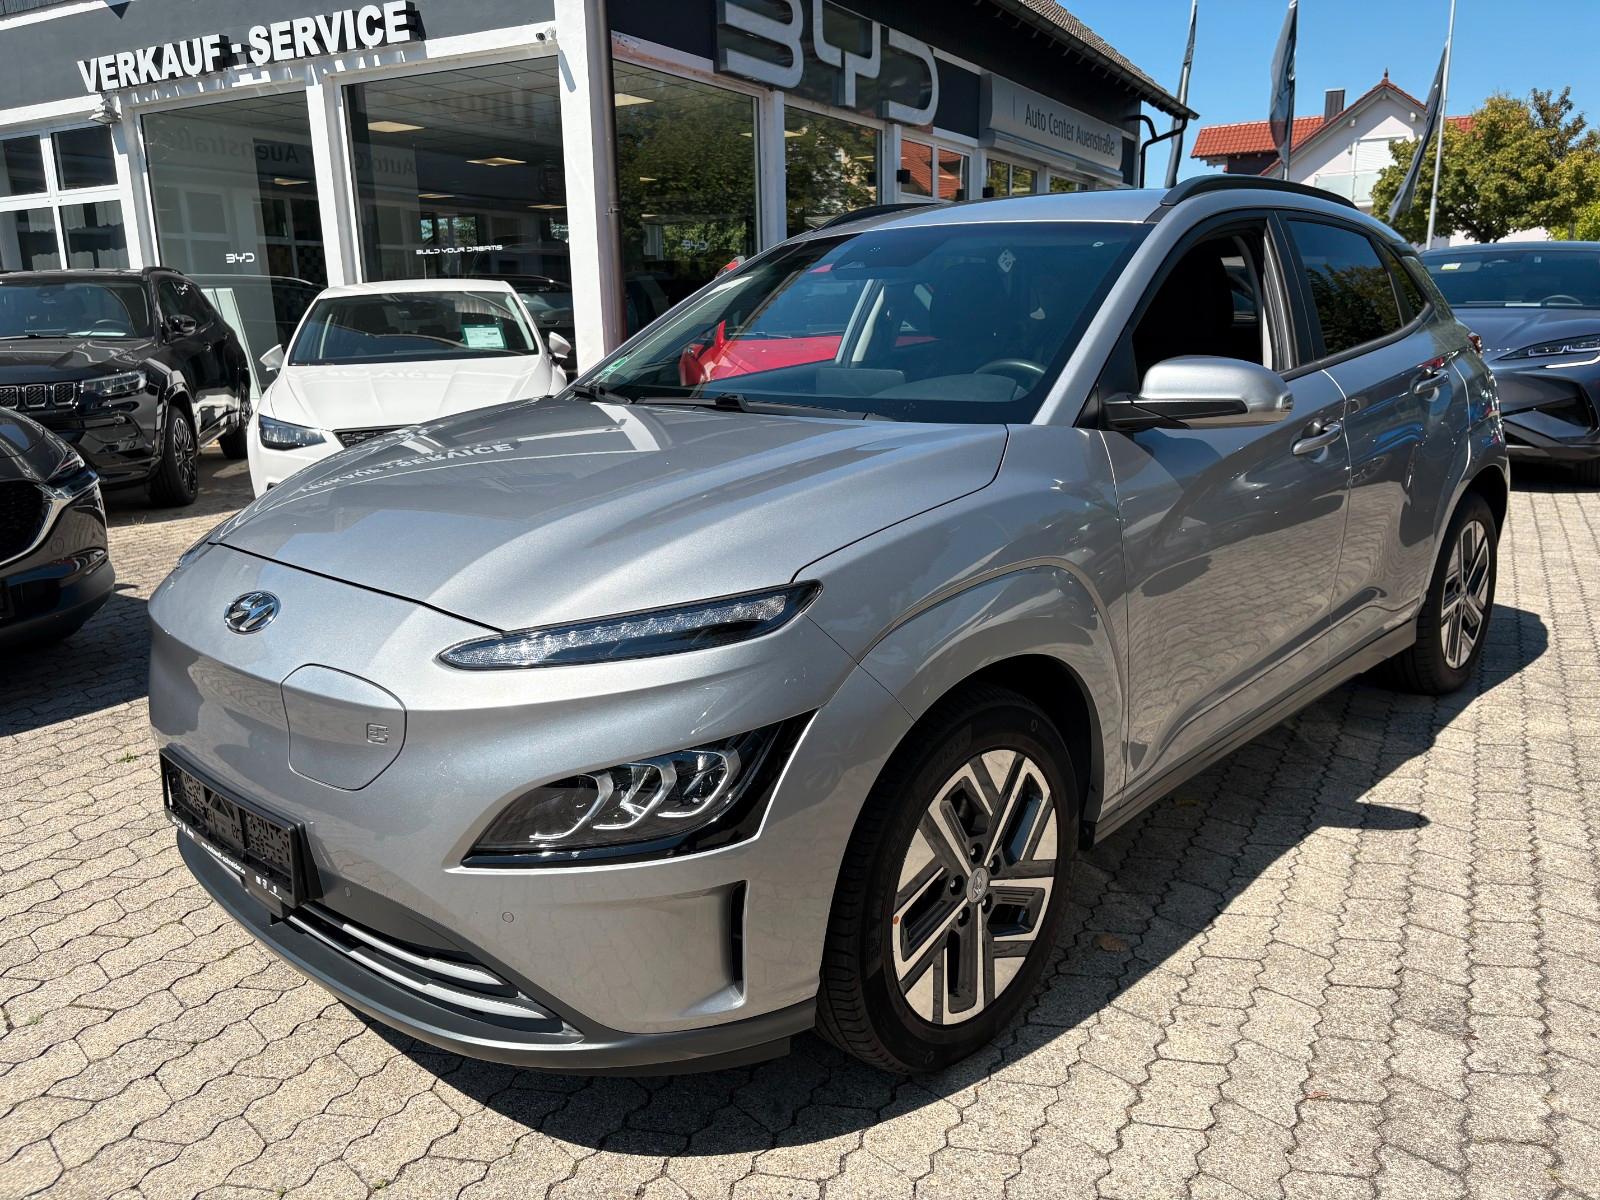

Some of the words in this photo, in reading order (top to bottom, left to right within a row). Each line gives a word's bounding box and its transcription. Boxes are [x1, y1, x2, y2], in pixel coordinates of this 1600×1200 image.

[76, 33, 221, 94] VERKAUF
[248, 0, 411, 66] SERVICE
[718, 0, 939, 126] BYD
[1024, 103, 1046, 132] Auto
[1048, 112, 1074, 142] Center
[1076, 125, 1116, 157] Auenstraße
[225, 252, 256, 264] BYD
[441, 246, 466, 254] YOUR
[466, 244, 503, 253] DREAMS
